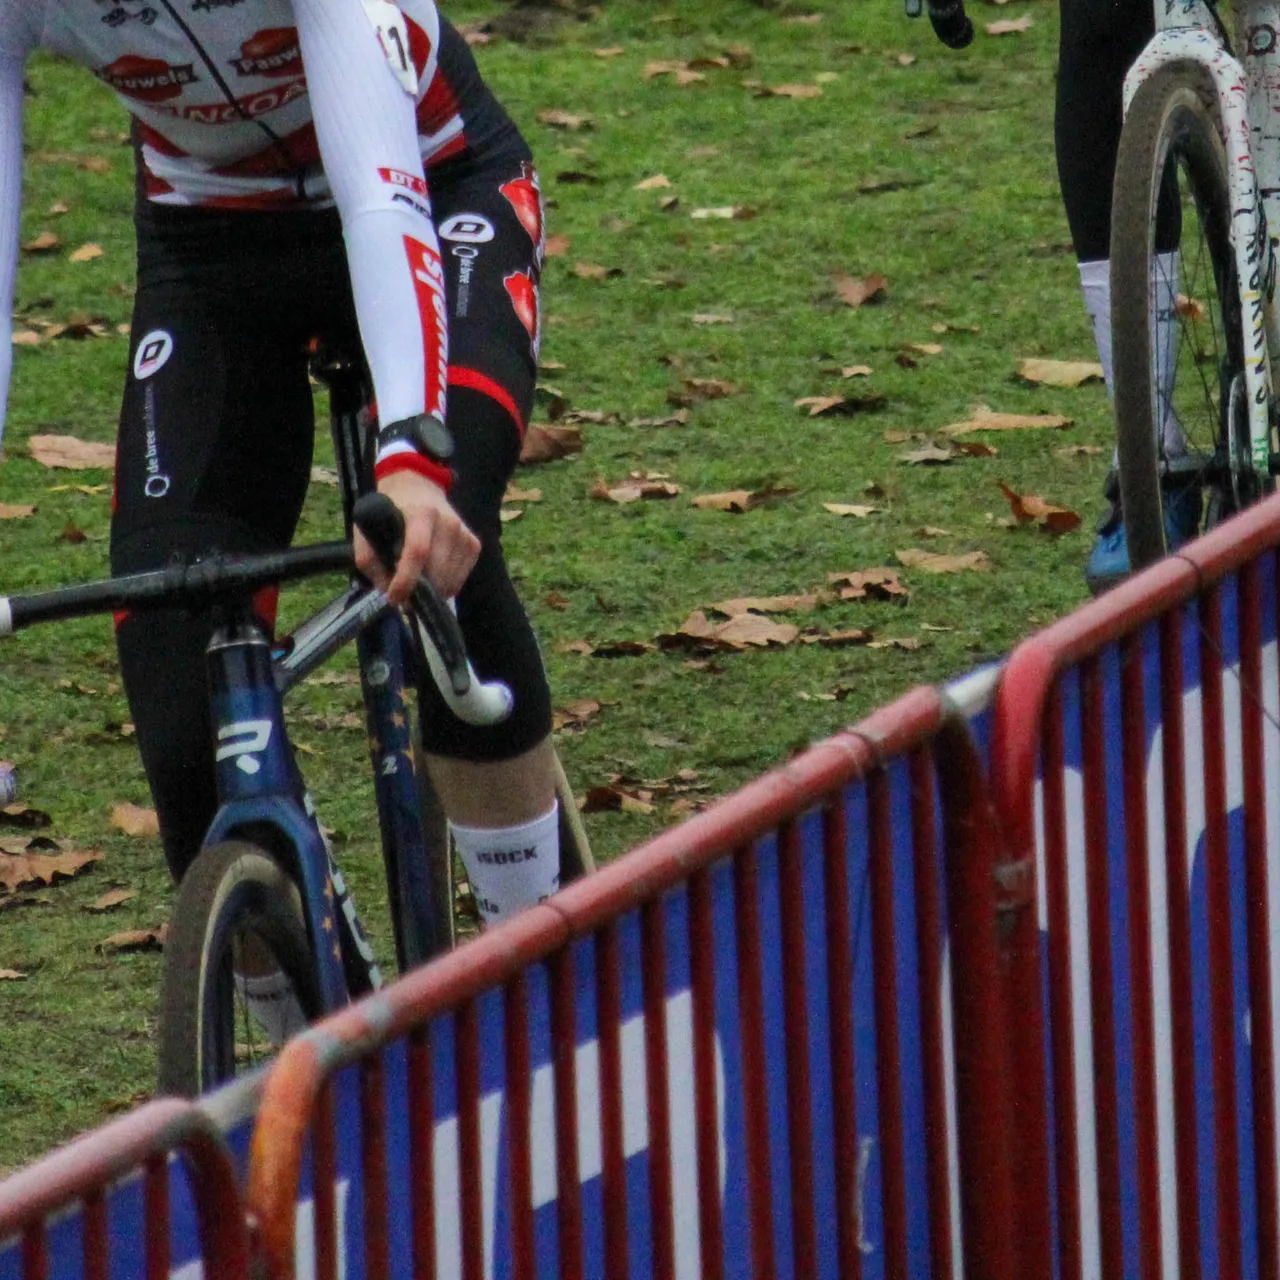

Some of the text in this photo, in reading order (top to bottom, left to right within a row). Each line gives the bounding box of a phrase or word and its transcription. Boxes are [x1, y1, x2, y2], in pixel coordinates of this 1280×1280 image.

[239, 47, 301, 73] Pauw
[114, 68, 191, 91] auwels
[145, 429, 158, 458] bree
